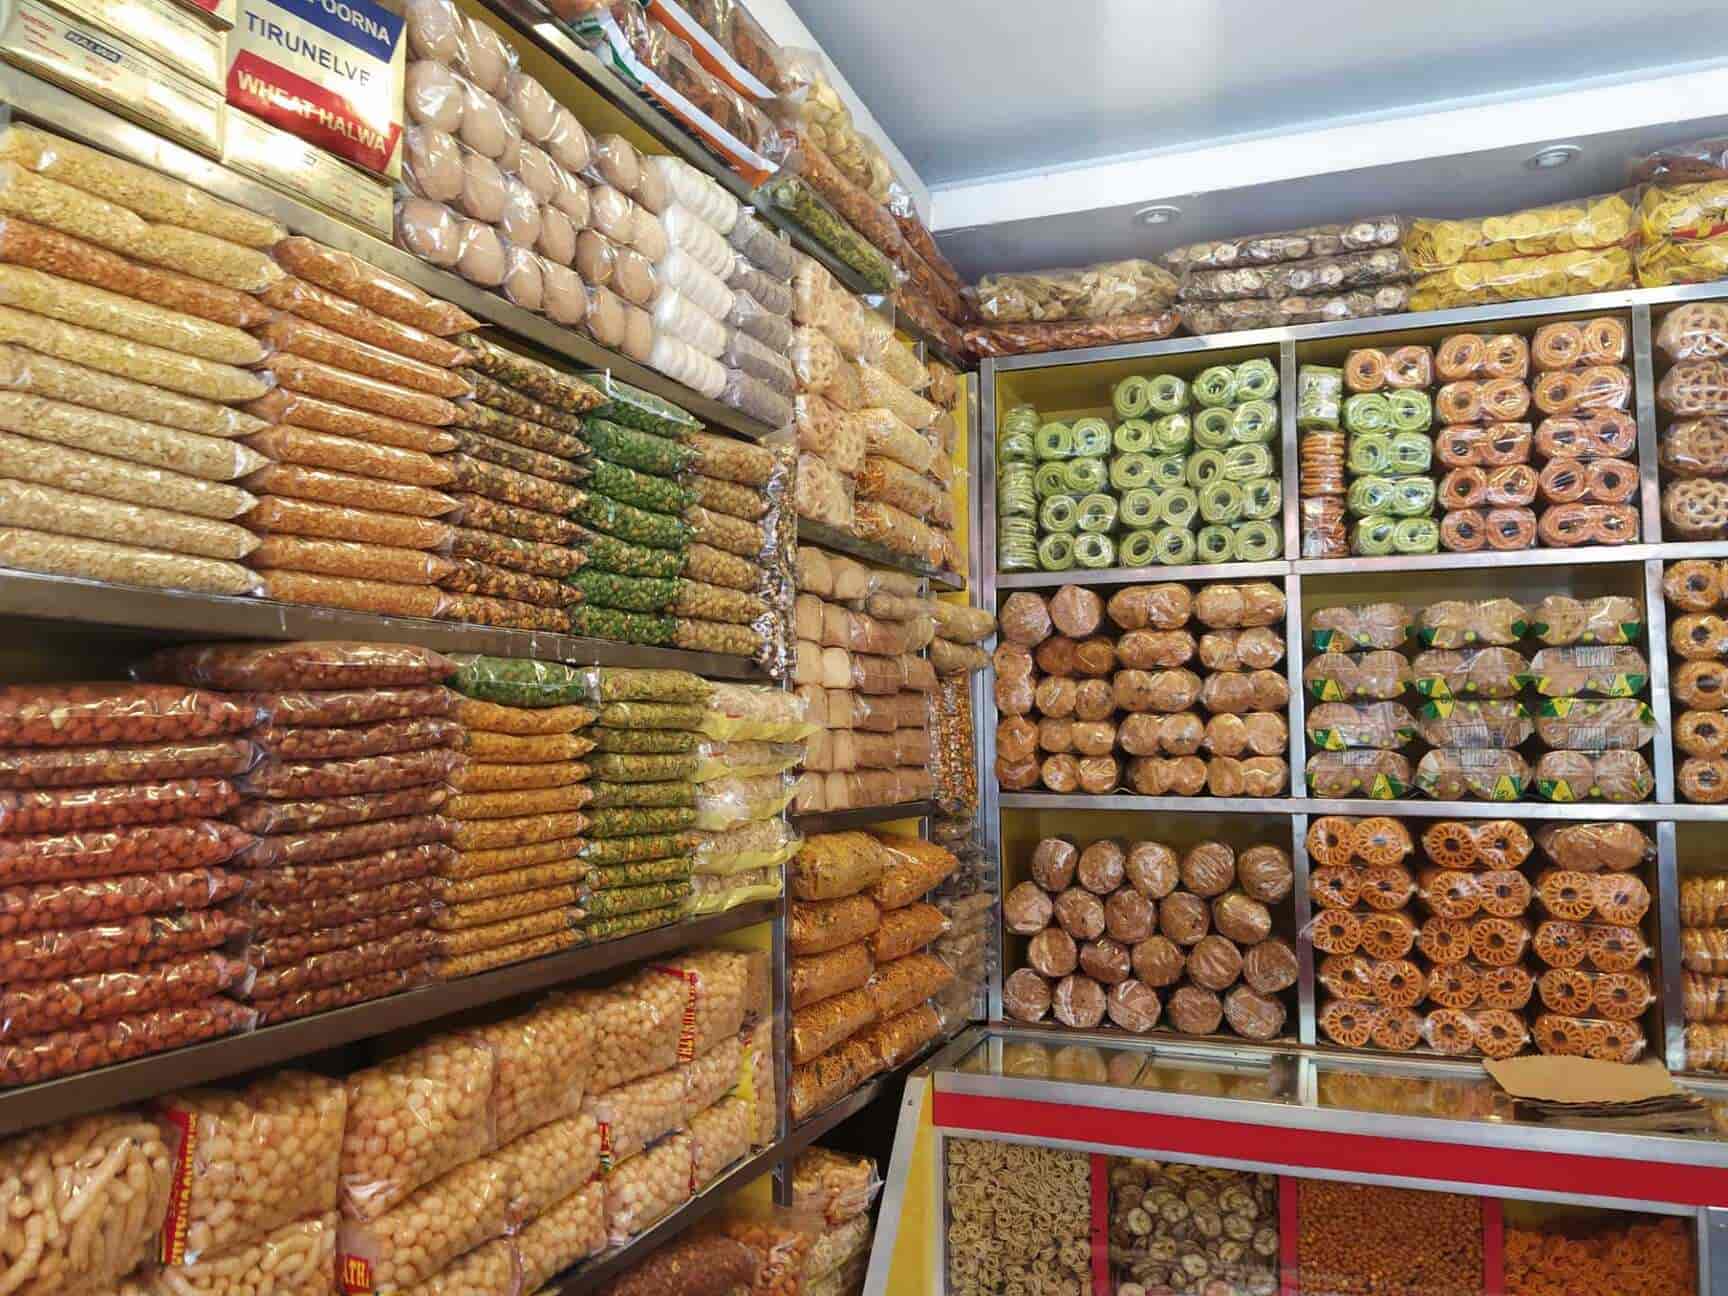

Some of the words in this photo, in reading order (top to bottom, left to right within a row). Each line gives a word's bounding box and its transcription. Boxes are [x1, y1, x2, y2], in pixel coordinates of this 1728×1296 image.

[309, 0, 391, 46] OORNA
[237, 69, 313, 119] WHEAT
[319, 108, 387, 154] HALWA
